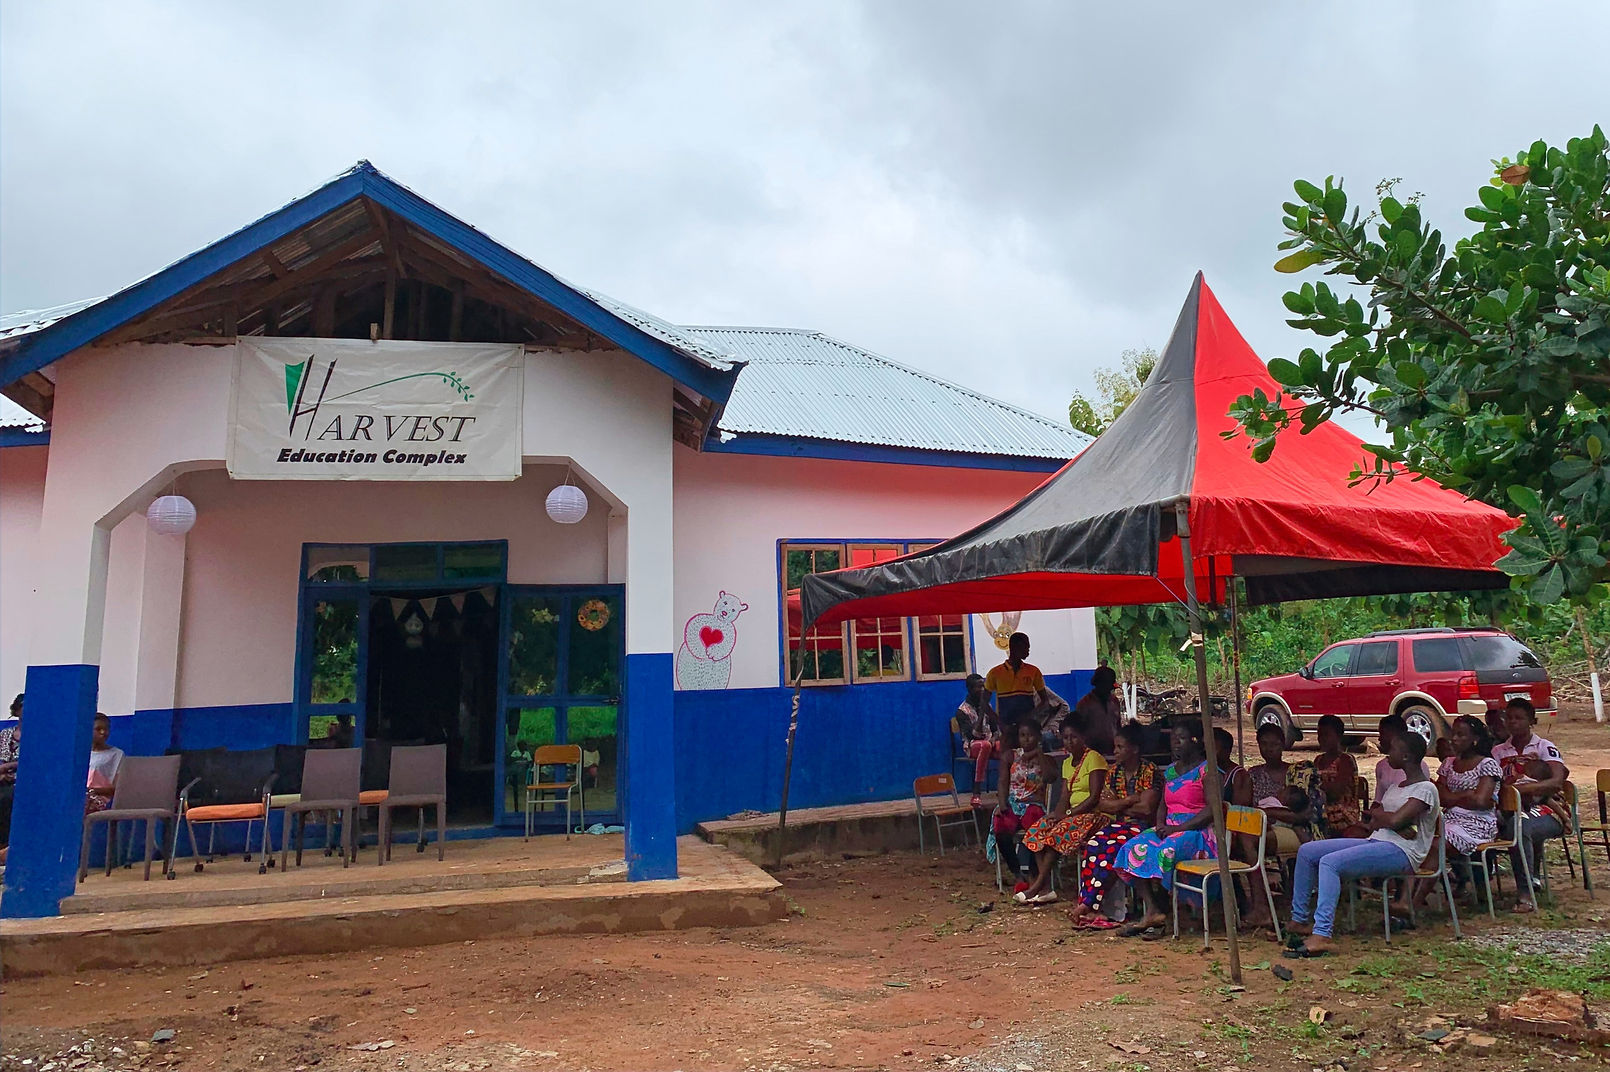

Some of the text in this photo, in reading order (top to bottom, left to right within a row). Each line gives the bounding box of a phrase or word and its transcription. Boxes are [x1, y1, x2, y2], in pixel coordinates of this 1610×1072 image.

[289, 354, 476, 441] HARVEST
[277, 448, 467, 466] Education Complex
